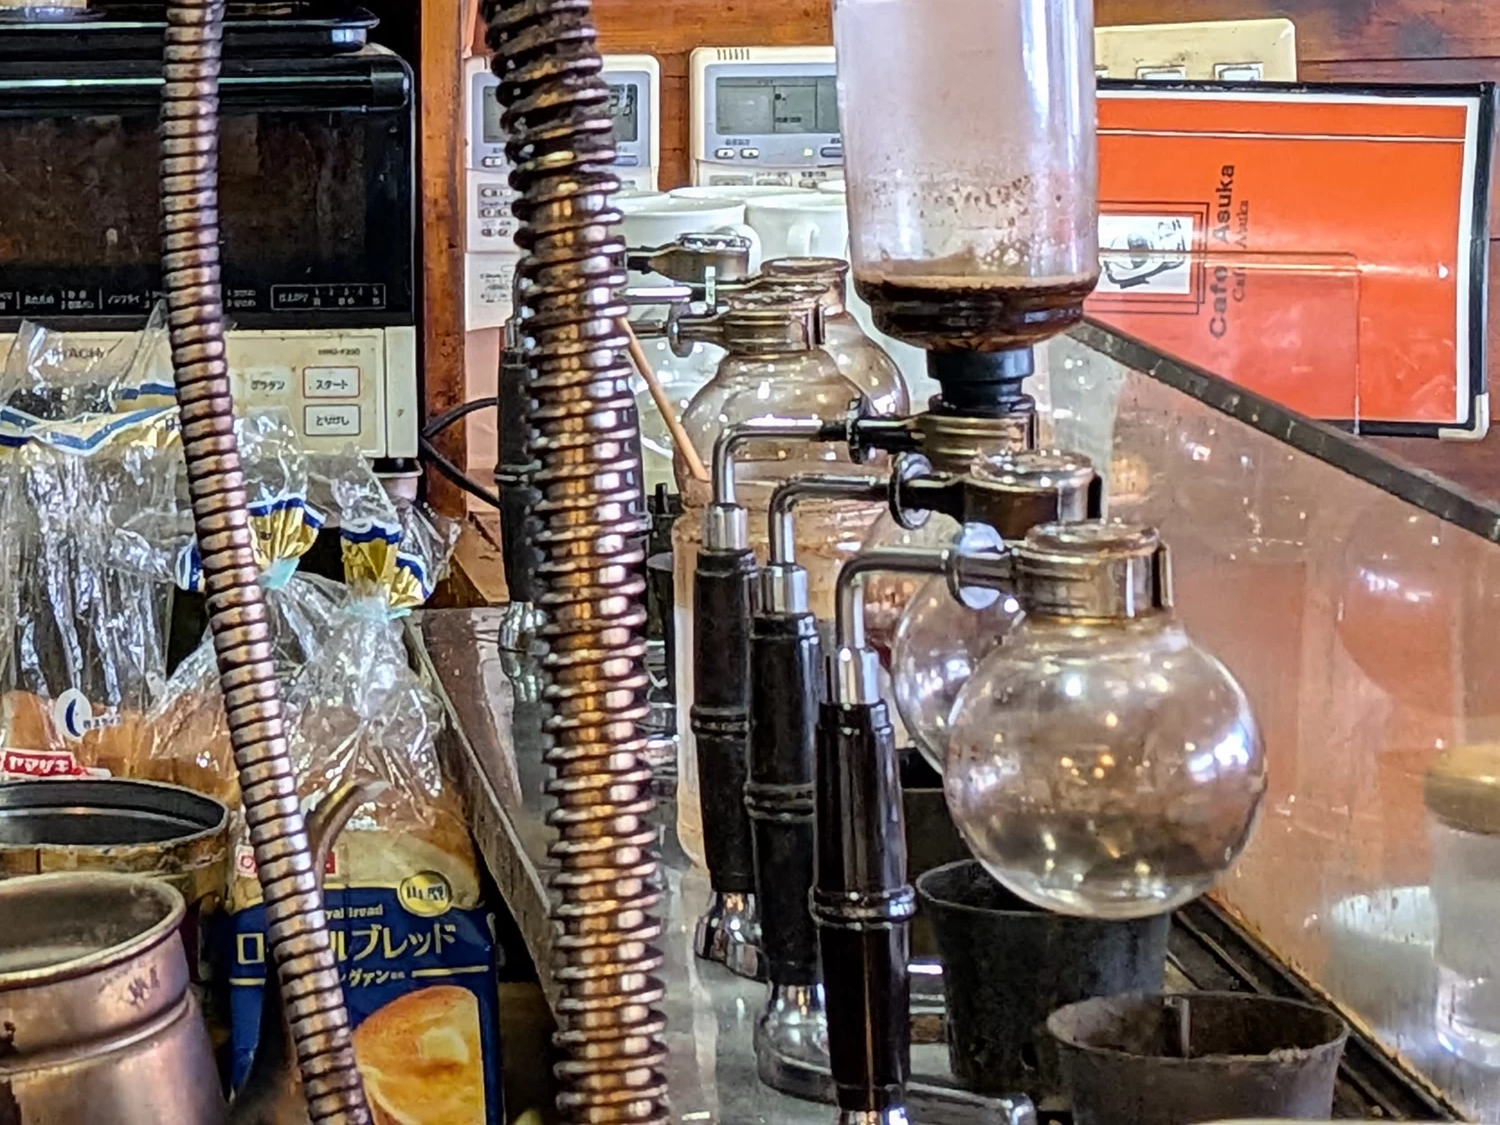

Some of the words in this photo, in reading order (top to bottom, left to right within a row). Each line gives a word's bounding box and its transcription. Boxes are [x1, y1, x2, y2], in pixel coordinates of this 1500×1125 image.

[1213, 164, 1235, 244] Asuka
[316, 379, 348, 390] スタート
[9, 757, 70, 773] ヤマザキ
[236, 923, 457, 965] ロルブレッド
